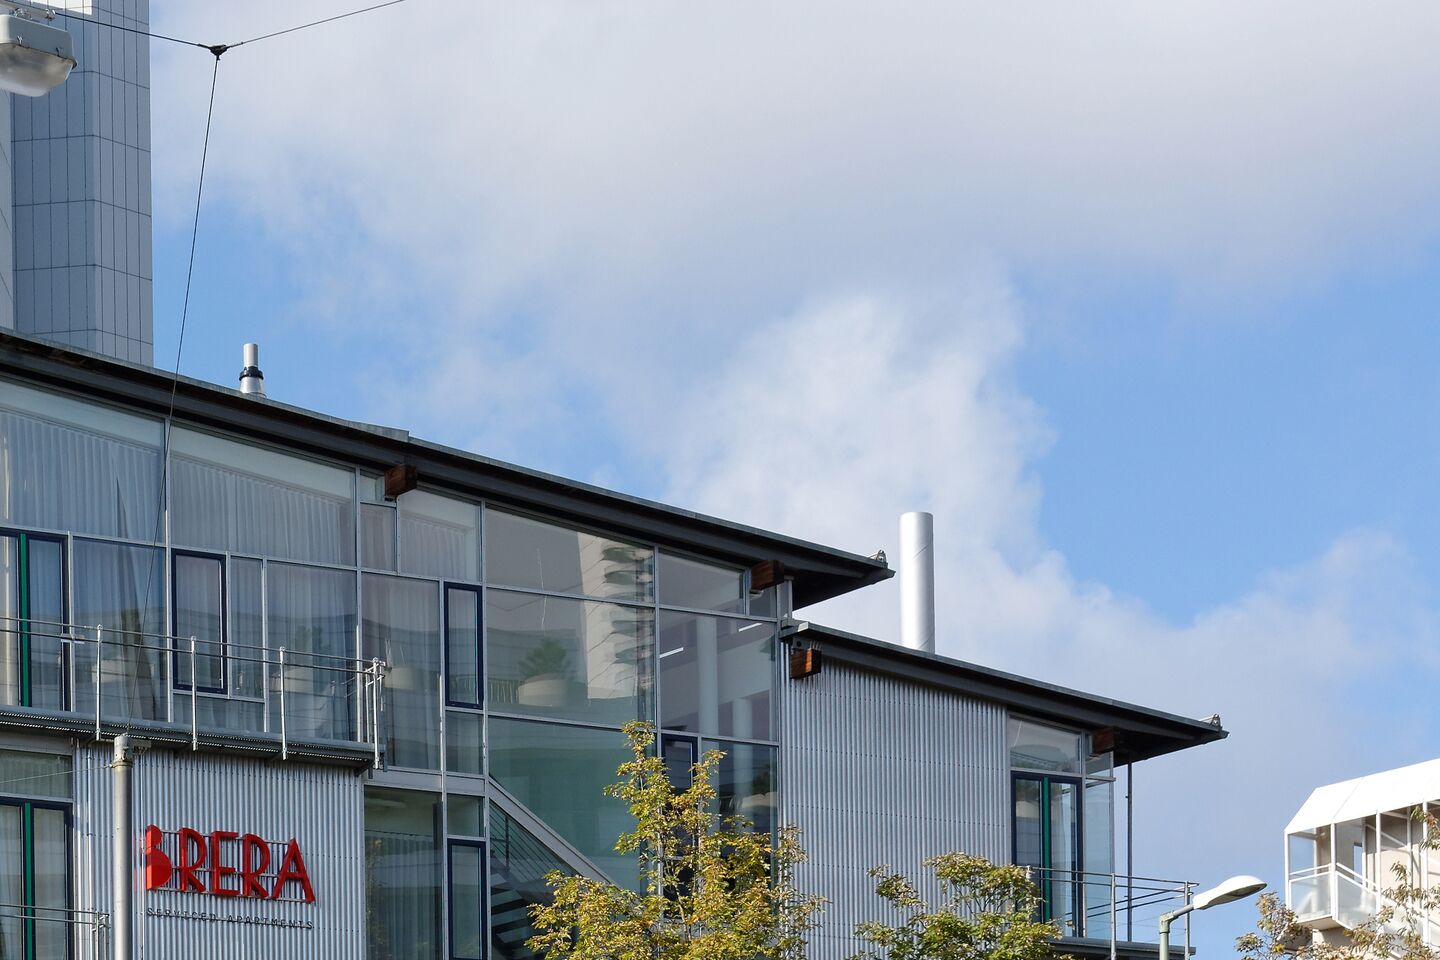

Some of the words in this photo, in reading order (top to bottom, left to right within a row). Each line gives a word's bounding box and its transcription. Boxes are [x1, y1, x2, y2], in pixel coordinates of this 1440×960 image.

[145, 824, 316, 903] BRERA
[146, 907, 217, 922] SERVICED
[226, 914, 314, 930] APARTMENTS
